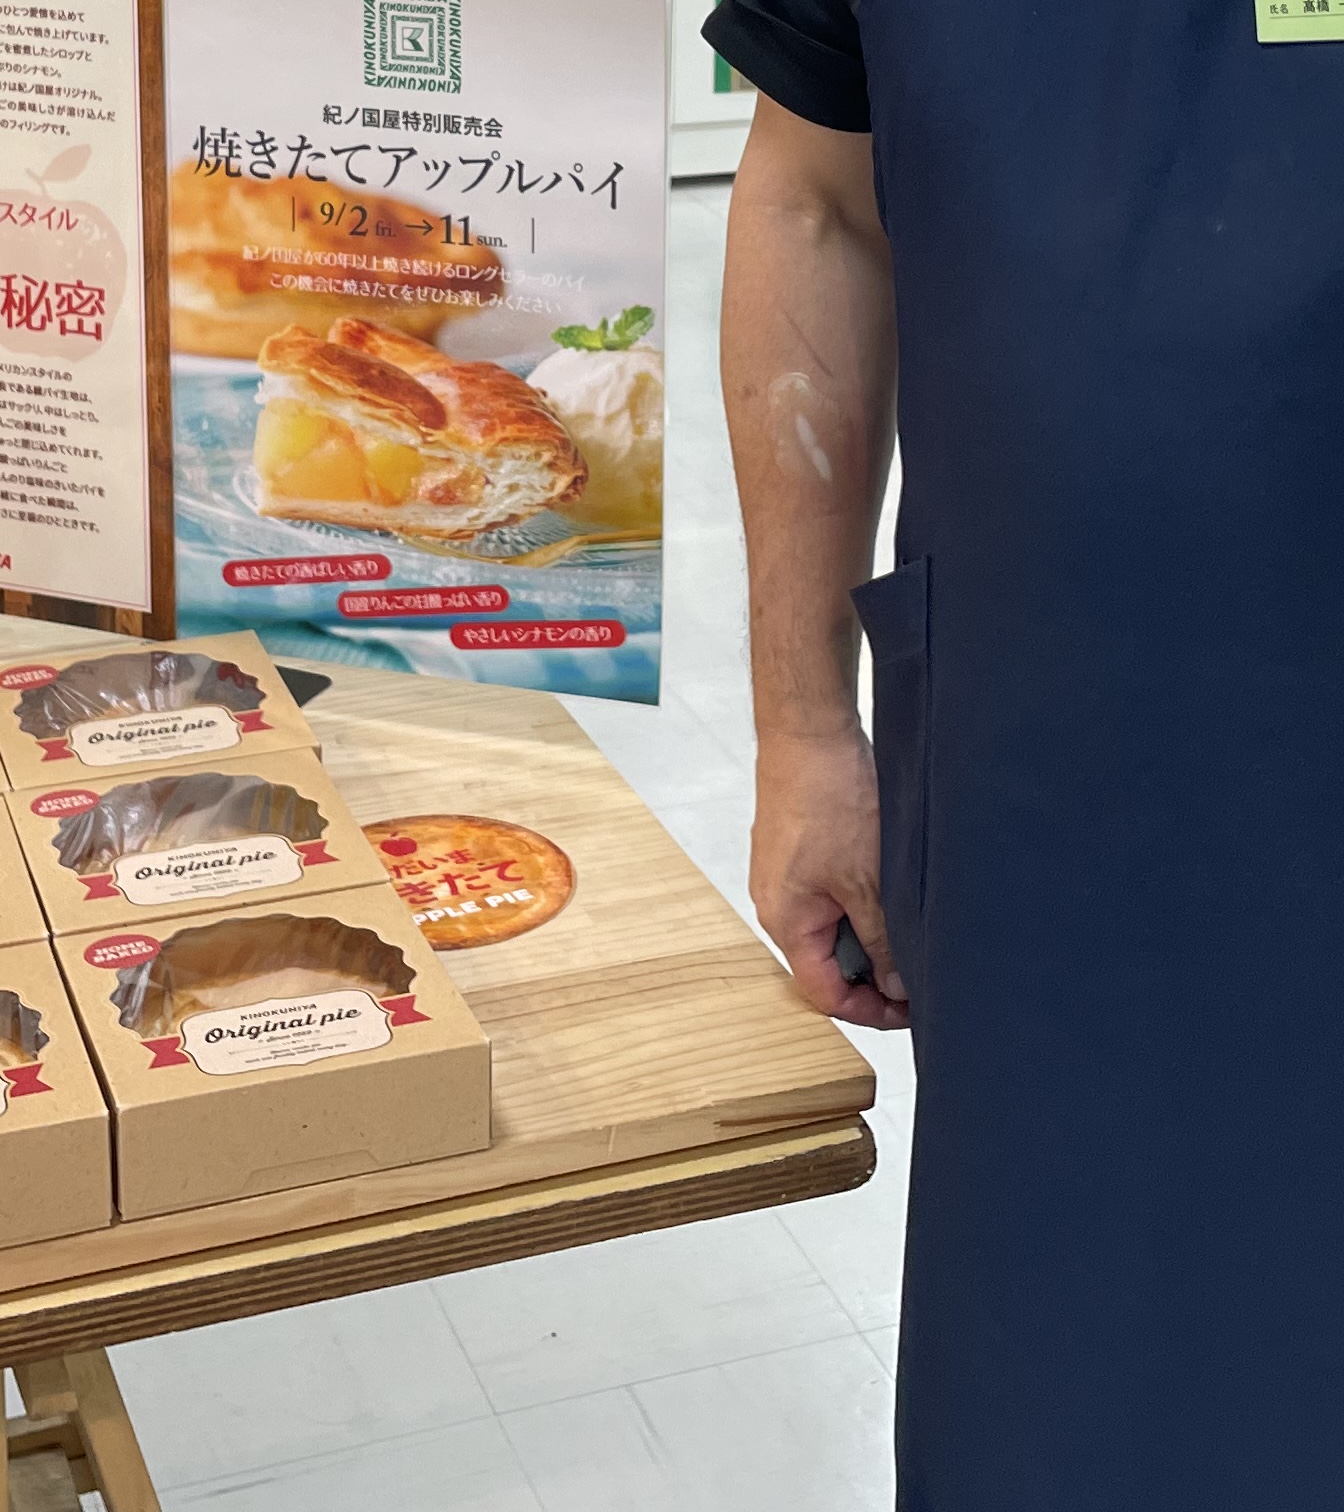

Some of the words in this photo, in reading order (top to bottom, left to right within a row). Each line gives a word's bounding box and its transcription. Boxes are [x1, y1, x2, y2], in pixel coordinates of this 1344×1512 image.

[377, 75, 461, 94] KINOKUNIYA
[322, 104, 504, 139] 紀ノ国屋特別販売会
[192, 123, 625, 210] 焼きたてアップルパイ
[319, 201, 369, 238] 9/2
[374, 218, 397, 238] fri.
[440, 214, 474, 247] 11
[477, 232, 508, 249] sun.
[87, 724, 177, 745] Original
[182, 719, 217, 733] pie
[134, 854, 235, 882] Original
[235, 848, 277, 867] pie
[396, 859, 525, 905] きたて
[411, 900, 482, 927] PPLE
[484, 888, 535, 908] PIE
[204, 1013, 316, 1044] Original
[318, 1007, 362, 1028] pie
